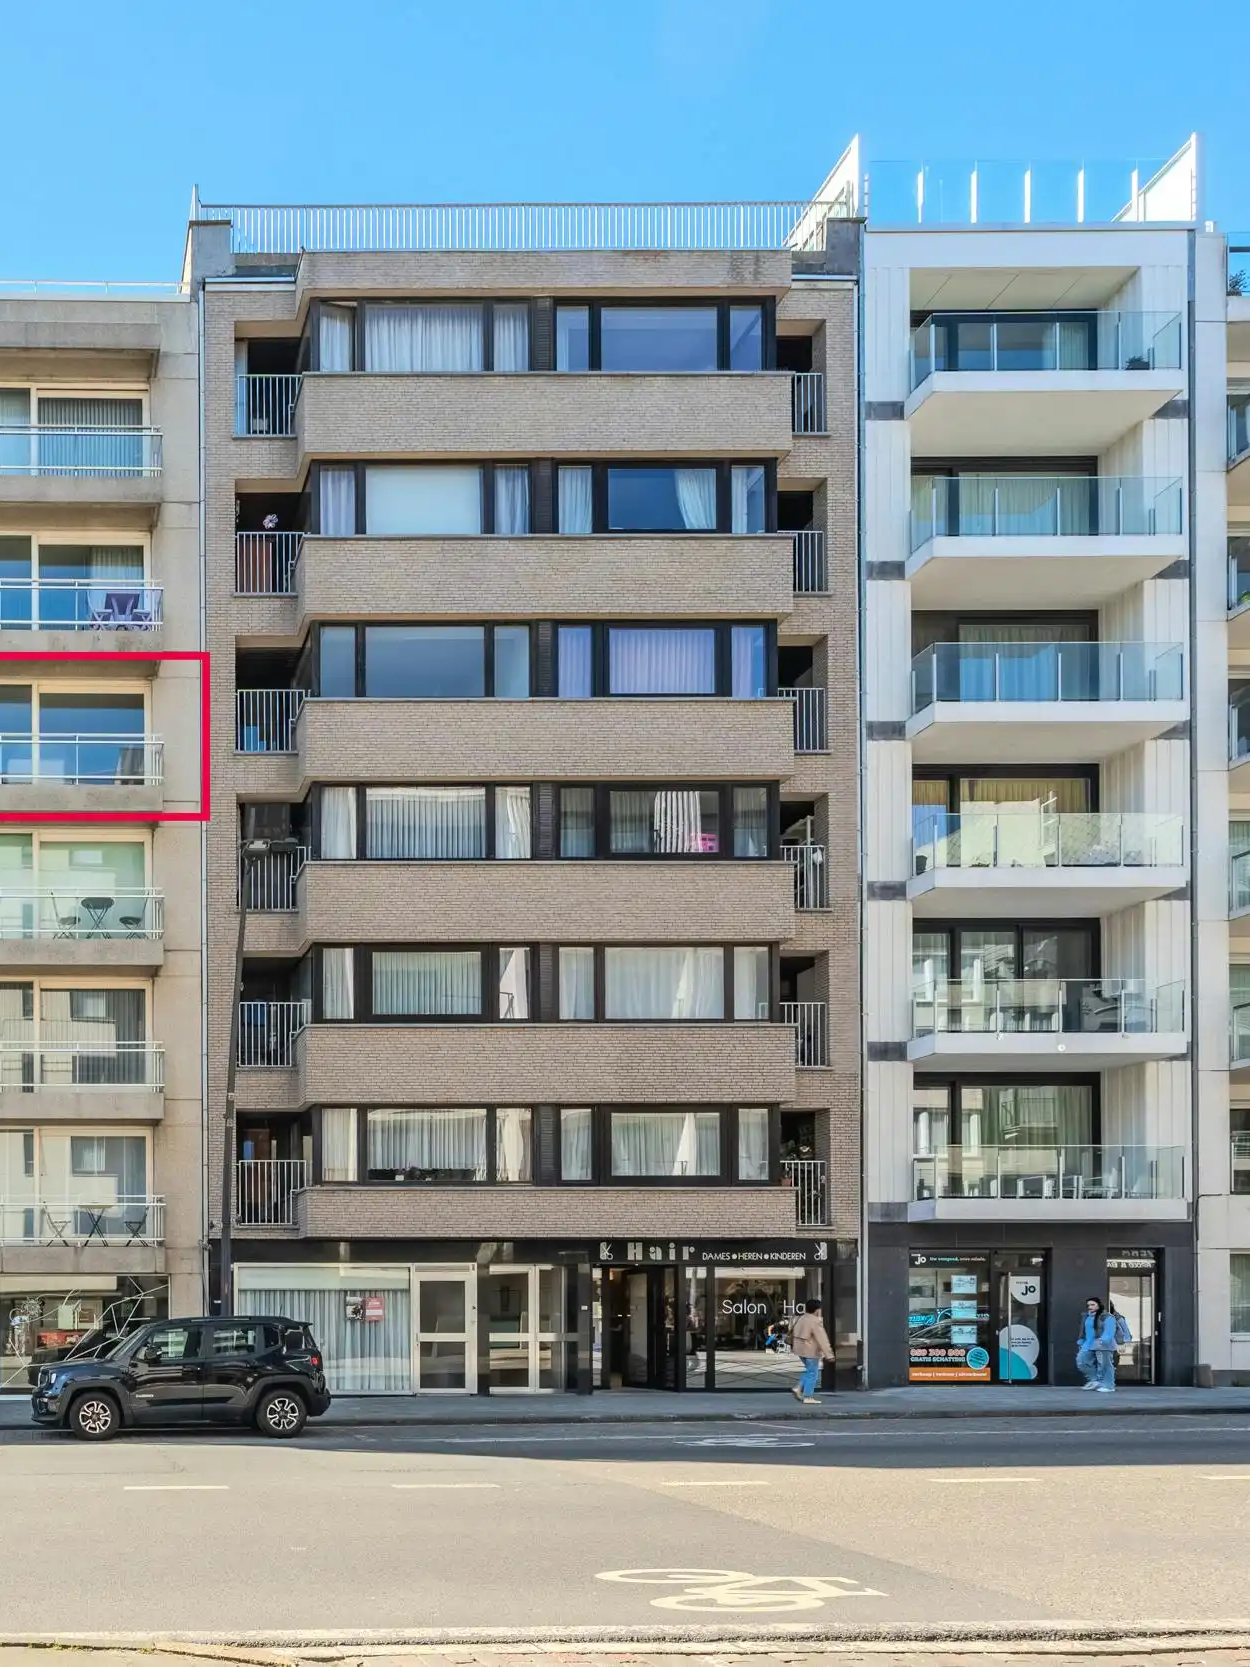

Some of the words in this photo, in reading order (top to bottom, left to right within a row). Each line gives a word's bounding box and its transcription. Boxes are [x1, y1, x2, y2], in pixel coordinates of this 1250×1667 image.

[627, 1242, 695, 1261] Hair
[702, 1252, 731, 1260] DAMES
[737, 1252, 763, 1260] HEREN
[769, 1252, 806, 1260] KINDEREN
[722, 1299, 767, 1314] Salon
[783, 1299, 807, 1314] Ha
